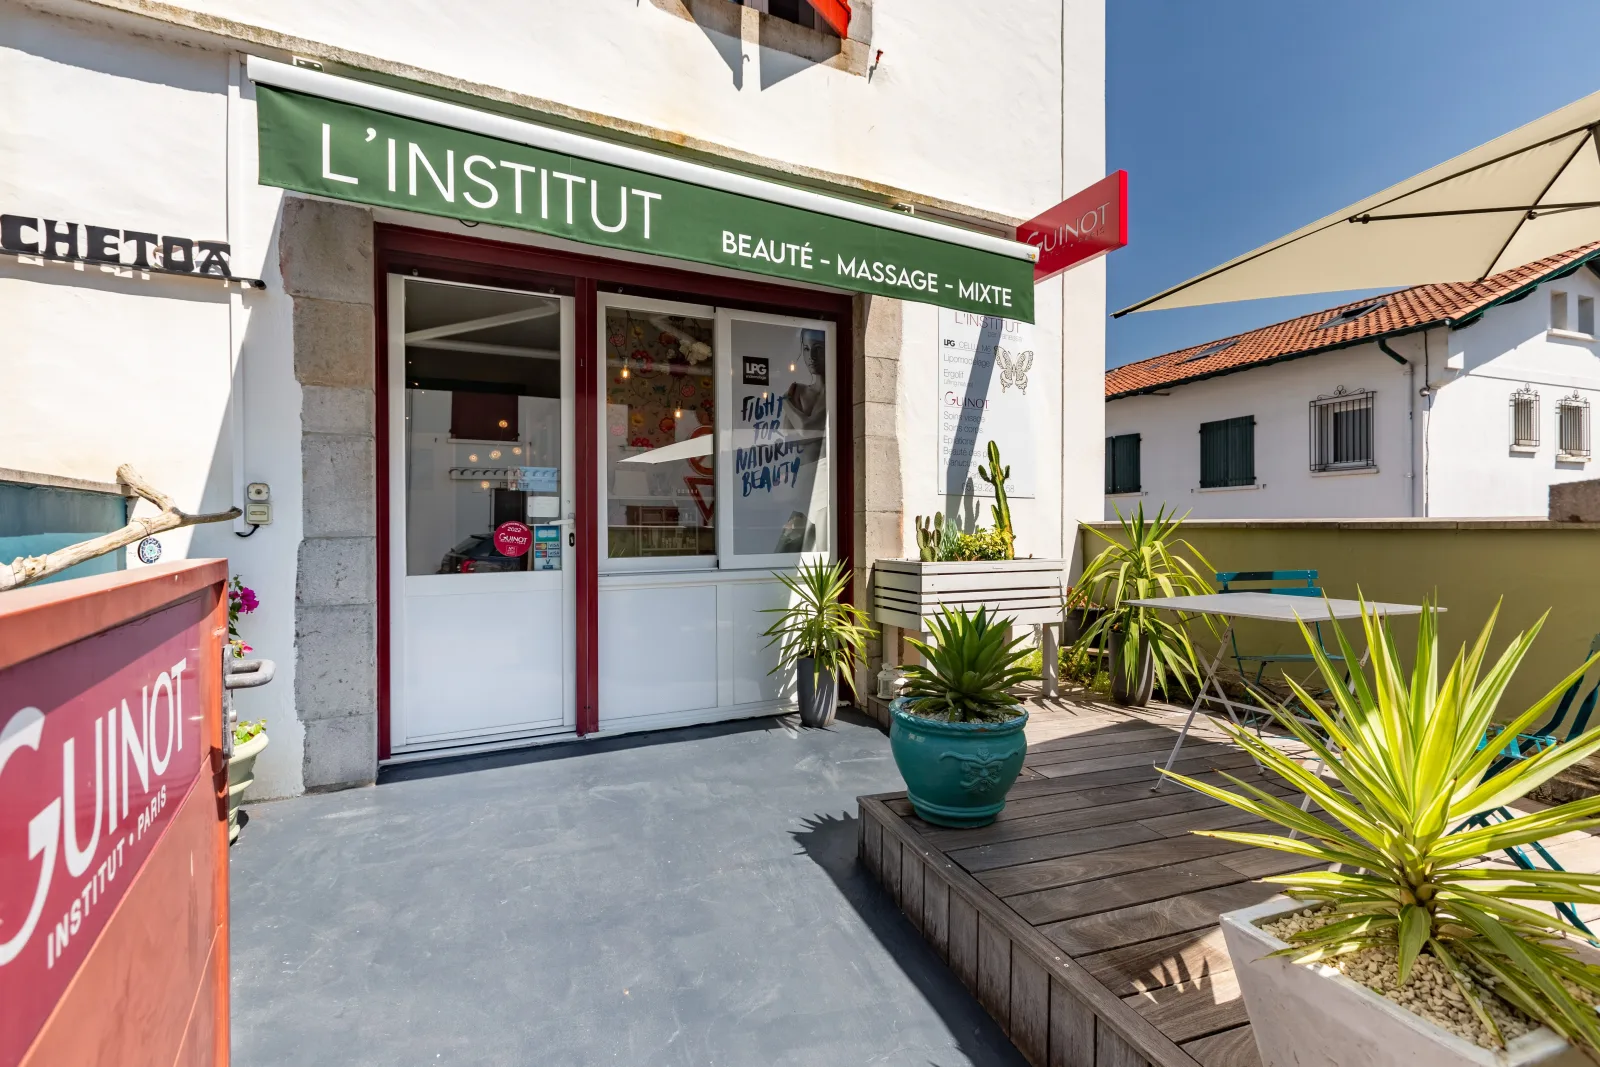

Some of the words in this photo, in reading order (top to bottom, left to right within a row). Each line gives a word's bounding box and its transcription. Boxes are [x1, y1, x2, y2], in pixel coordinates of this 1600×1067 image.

[0, 213, 231, 278] CHETOA
[722, 230, 813, 270] BEAUTÉ
[837, 253, 938, 293] MASSAGE
[958, 278, 1012, 307] MIXTE
[954, 311, 1022, 333] L'INSTITUT
[943, 338, 955, 347] LPG
[745, 362, 767, 375] LPG
[740, 392, 788, 422] FIGHT
[944, 391, 990, 409] GUINOT
[752, 419, 784, 445] FOR
[735, 440, 804, 474] NATURAL
[741, 457, 800, 497] BEAUTY
[499, 532, 528, 543] GUINOT
[47, 843, 125, 970] INSTITUT
[137, 784, 168, 847] PARIS
